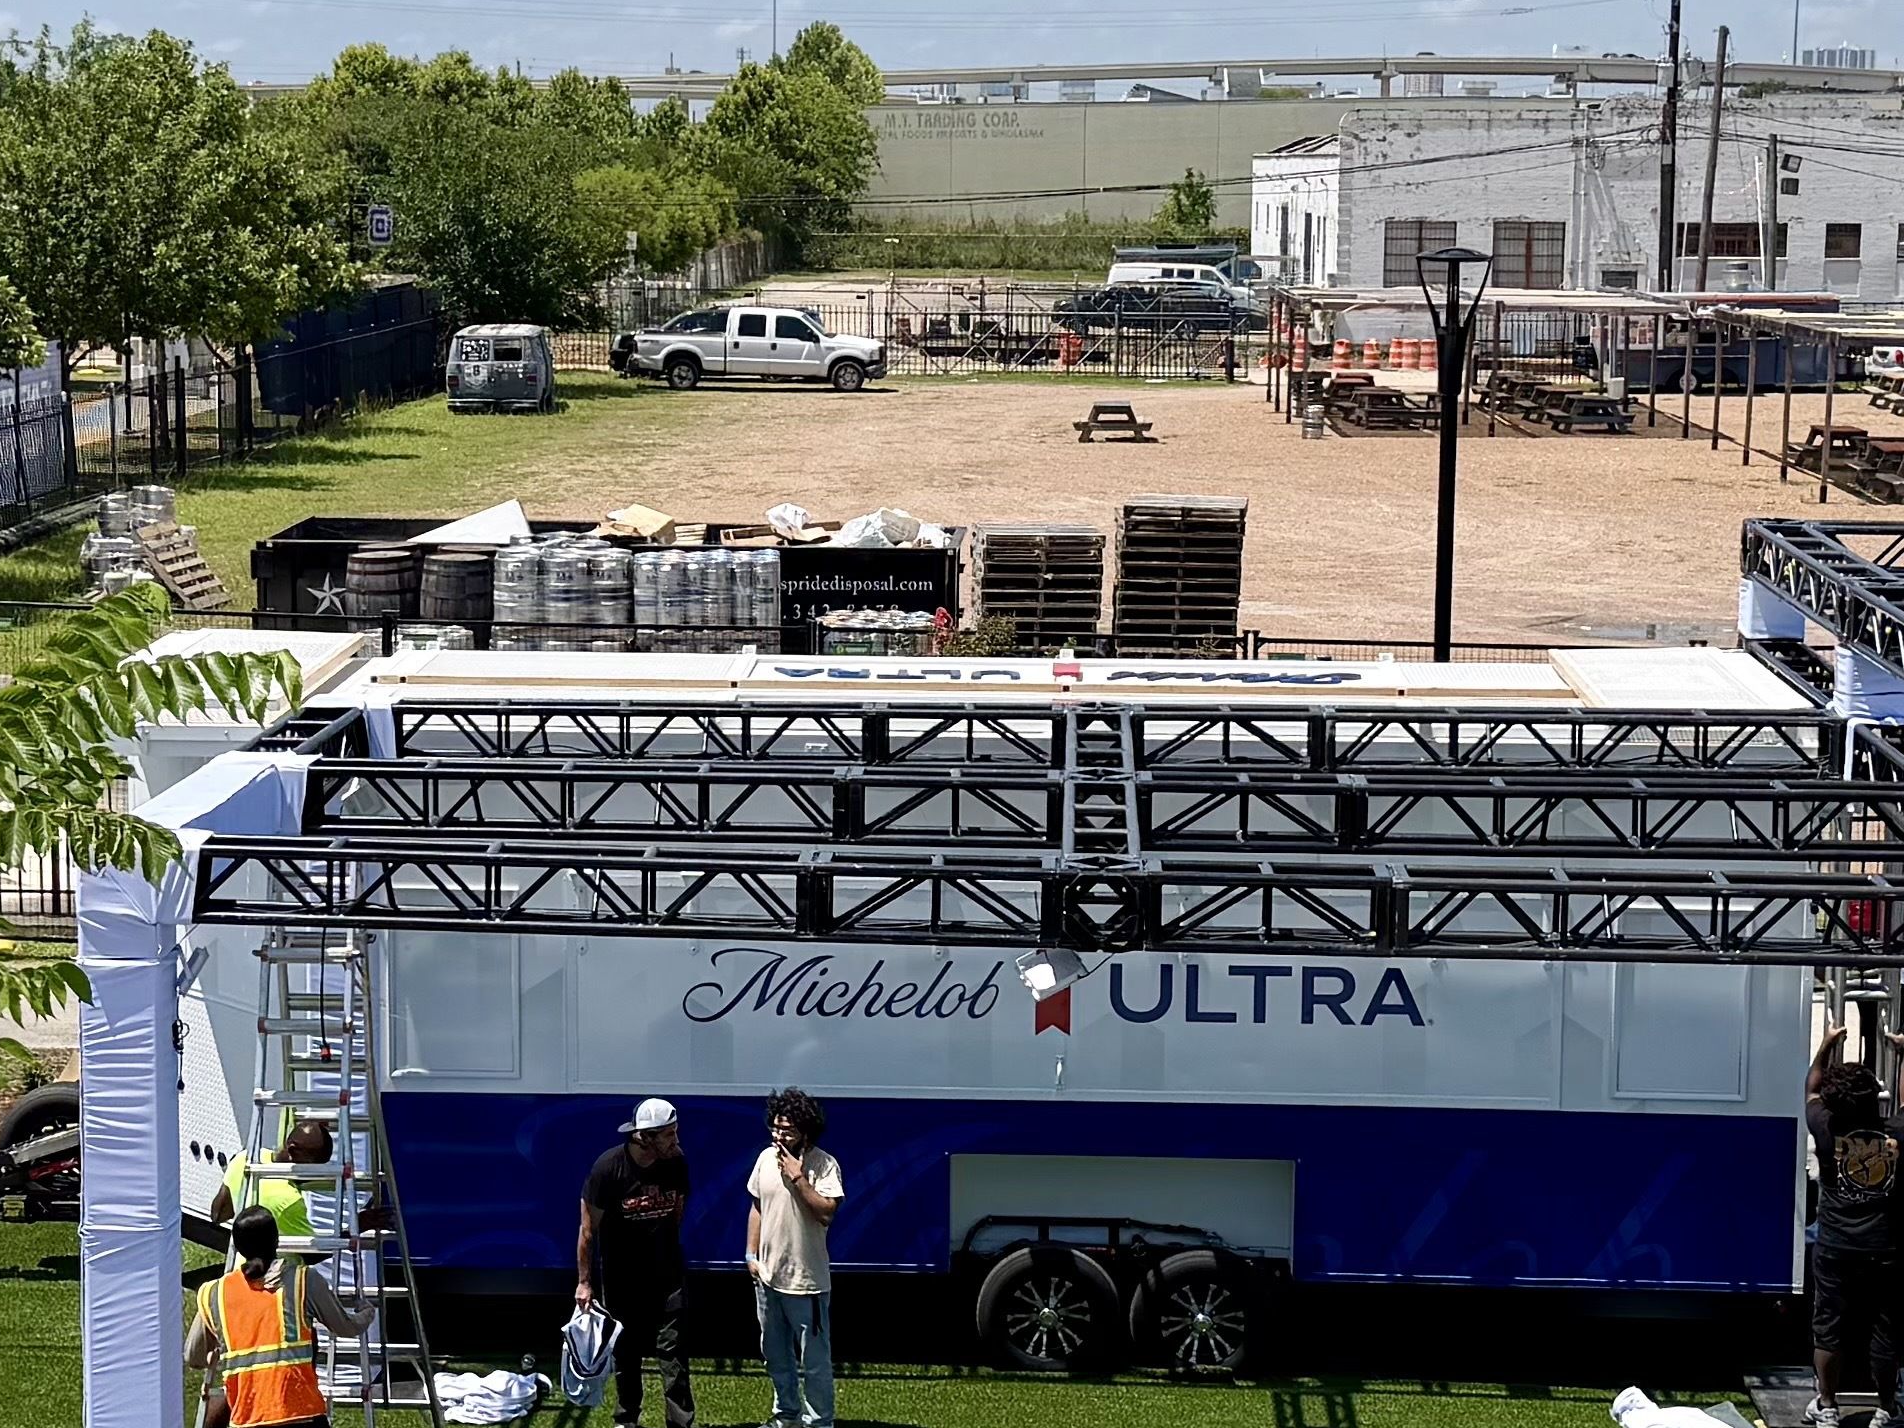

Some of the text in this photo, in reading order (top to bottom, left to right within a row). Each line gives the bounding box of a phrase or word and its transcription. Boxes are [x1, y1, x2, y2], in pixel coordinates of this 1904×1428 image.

[916, 112, 976, 129] TRADING
[982, 111, 1021, 129] CORP.
[779, 574, 934, 596] spridedisposal.com
[682, 948, 1426, 1027] Michelob ULTRA
